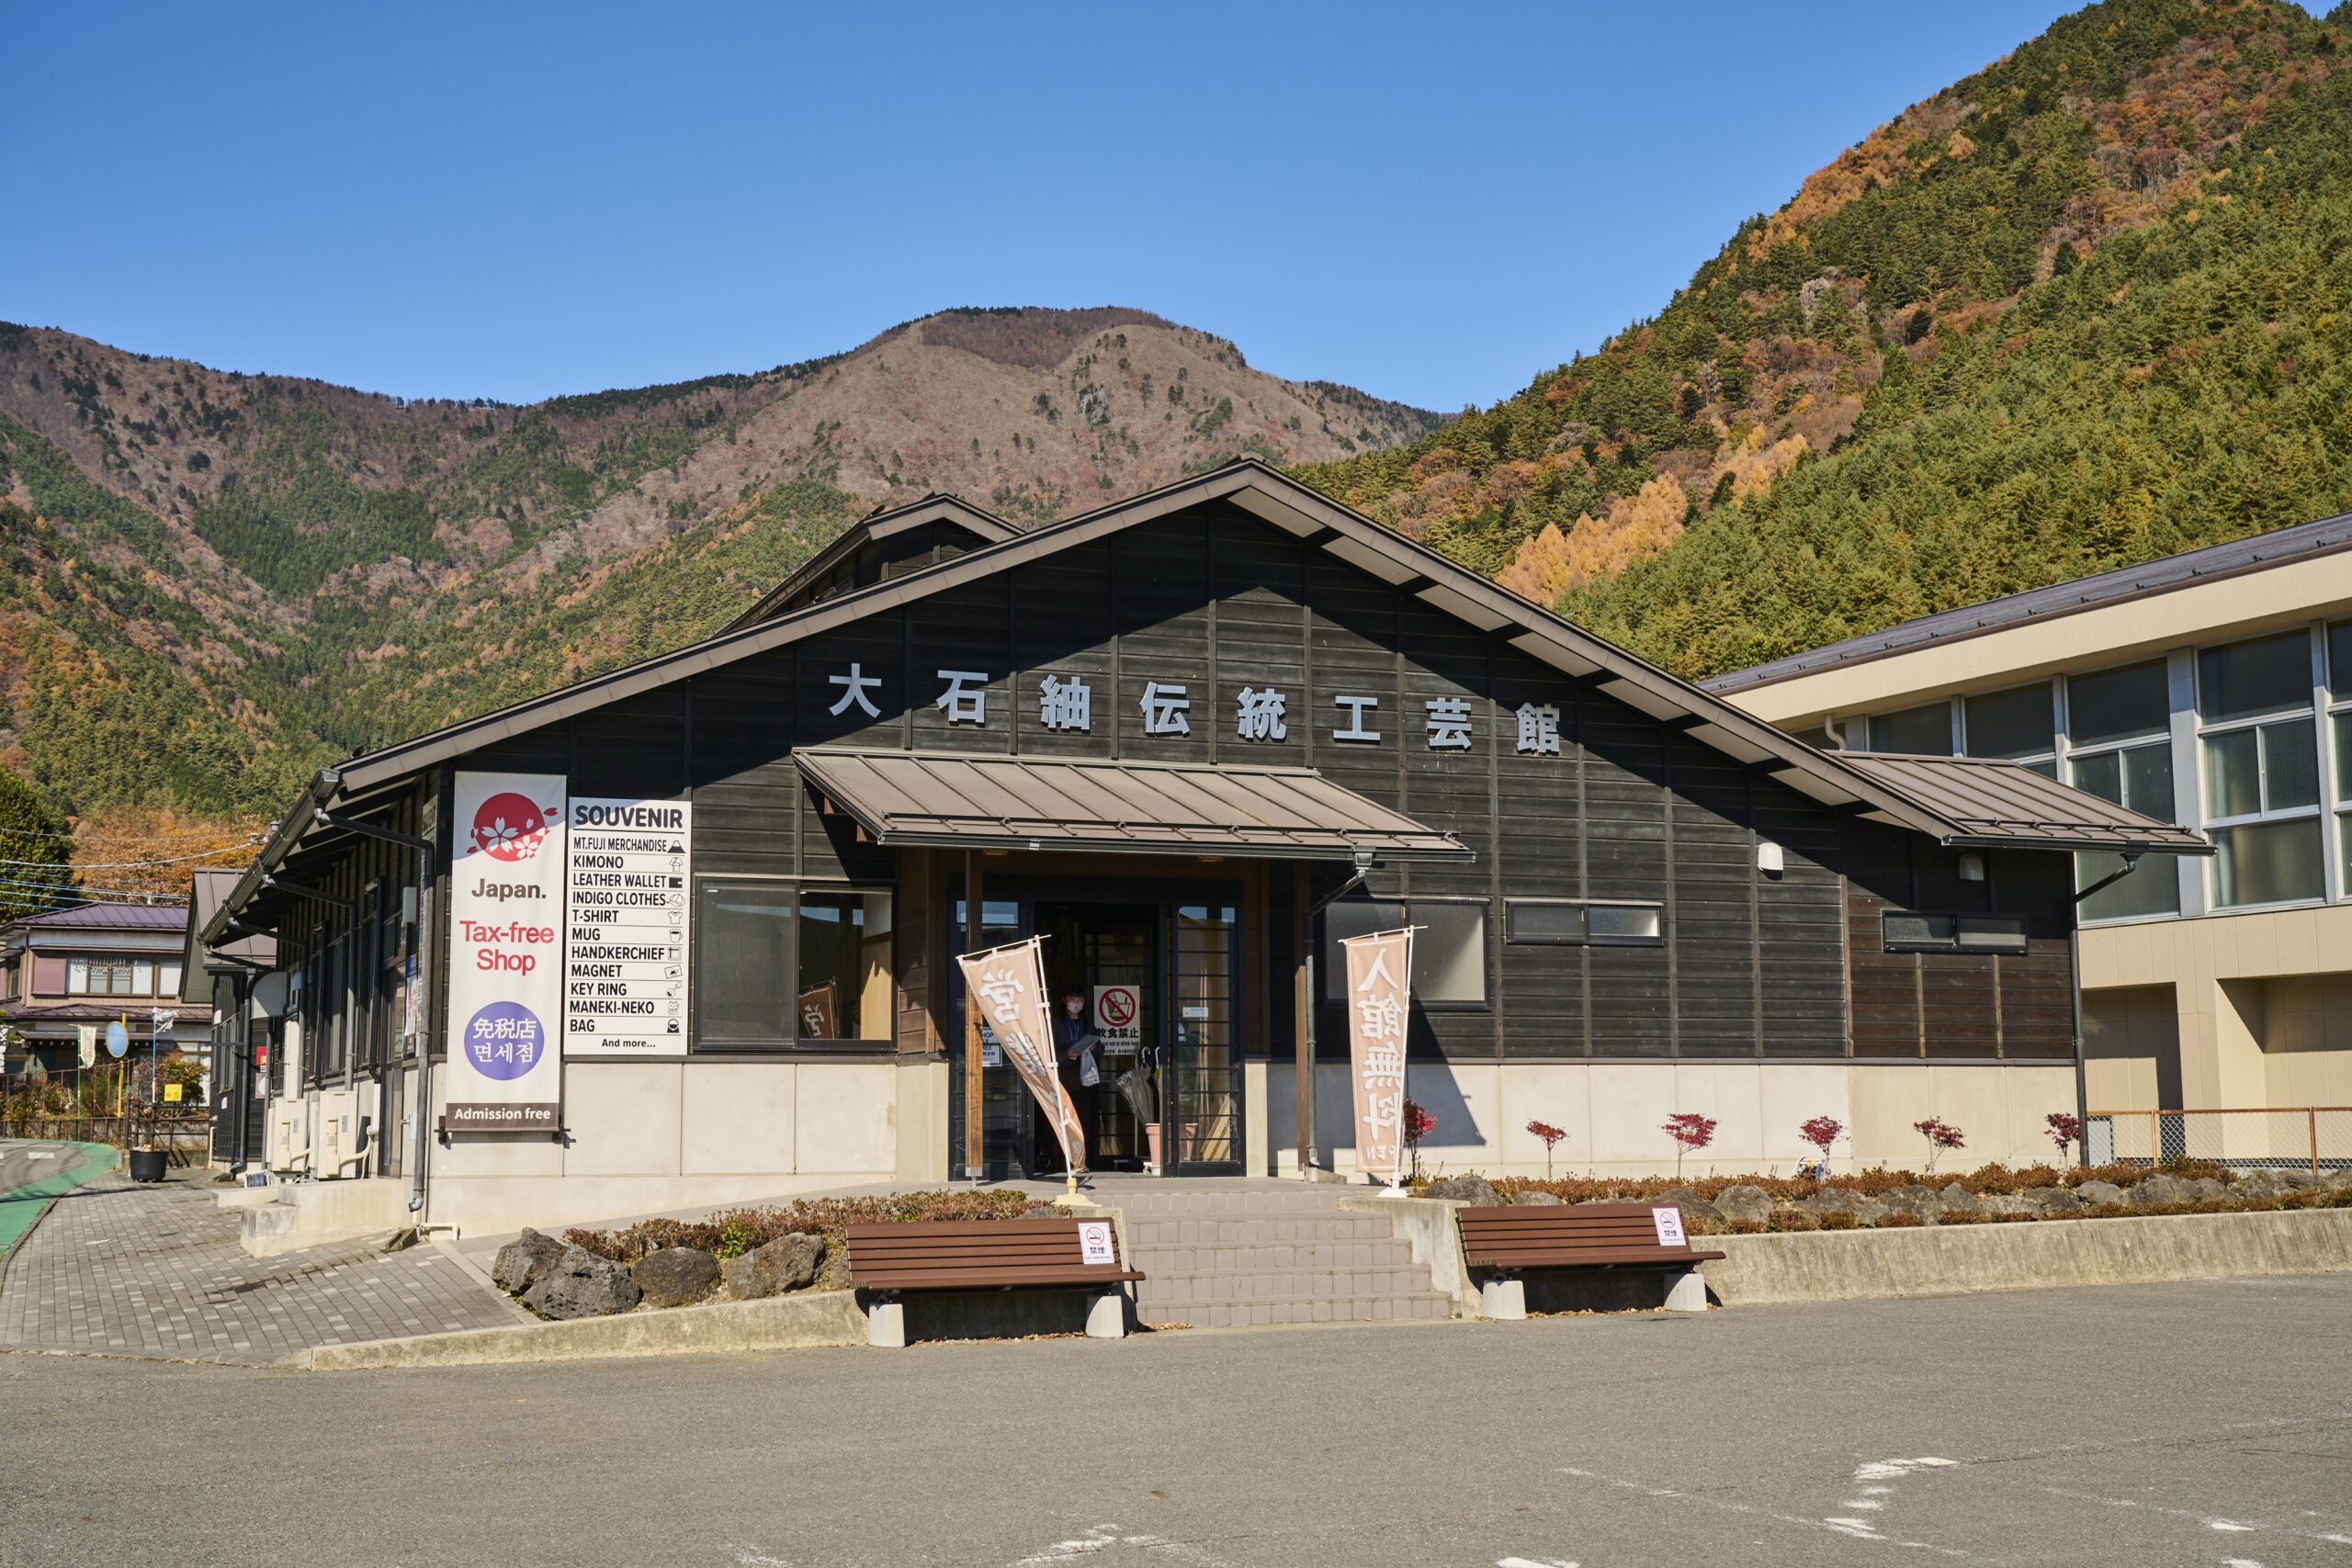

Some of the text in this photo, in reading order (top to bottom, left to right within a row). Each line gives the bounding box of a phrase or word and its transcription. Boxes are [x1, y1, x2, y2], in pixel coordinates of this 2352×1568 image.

[829, 662, 1561, 755] 大石紬伝統工芸館
[574, 805, 683, 829] SOUVENIR
[573, 837, 667, 852] MT.FUJI MERCHANDISE
[573, 855, 624, 869] KIMONO
[572, 873, 667, 888] LEATHER WALLET
[471, 878, 547, 902] Japan.
[572, 891, 666, 907] INDIGO CLOTHES
[571, 909, 619, 923] T-SHIRT
[459, 920, 555, 943] Tax-free
[571, 928, 601, 941] MUG
[571, 946, 665, 960] HANDKERCHIEF
[476, 948, 536, 976] Shop
[571, 964, 623, 977] MAGNET
[571, 983, 628, 996] KEY RING
[570, 1000, 654, 1014] MANEKI-NEKO
[472, 1018, 537, 1039] 免税店
[570, 1019, 595, 1032] BAG
[602, 1039, 620, 1047] And
[473, 1042, 534, 1064] 면세점
[454, 1107, 551, 1120] Admission free
